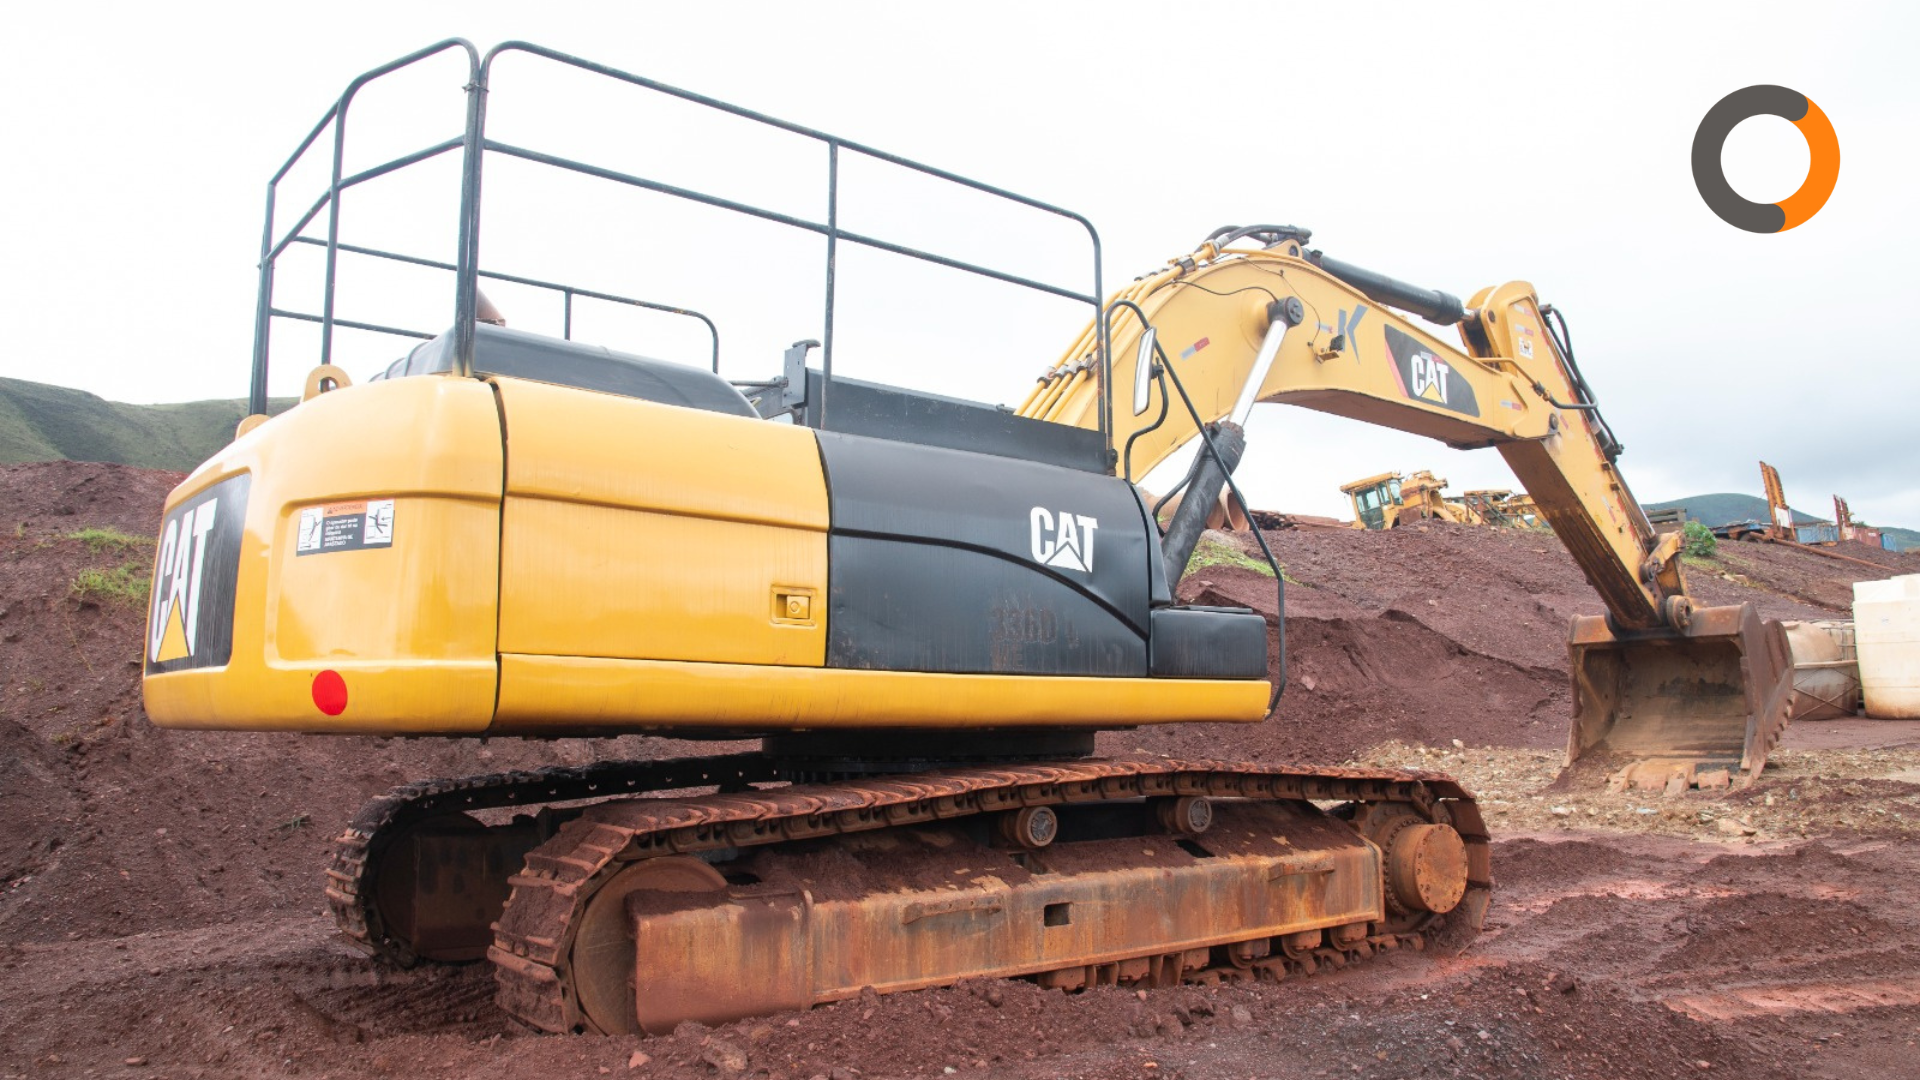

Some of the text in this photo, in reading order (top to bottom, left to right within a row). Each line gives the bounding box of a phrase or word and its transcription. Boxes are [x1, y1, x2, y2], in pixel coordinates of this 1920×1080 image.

[1411, 354, 1449, 404] CAT
[1030, 506, 1098, 573] CAT
[151, 497, 218, 663] CAT
